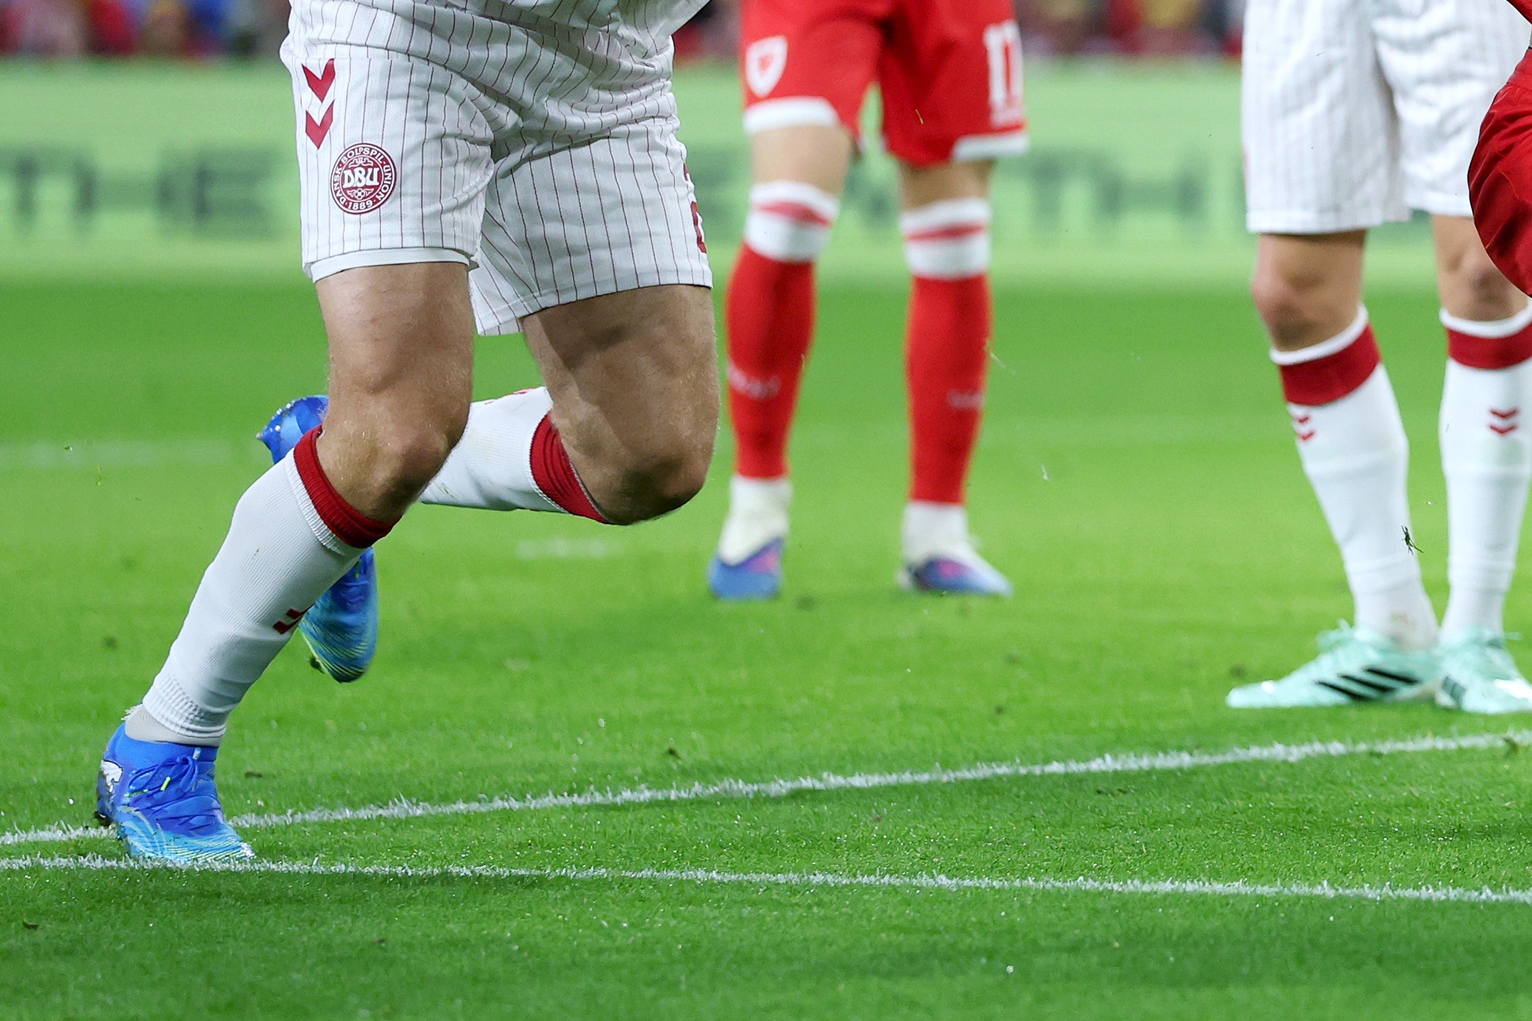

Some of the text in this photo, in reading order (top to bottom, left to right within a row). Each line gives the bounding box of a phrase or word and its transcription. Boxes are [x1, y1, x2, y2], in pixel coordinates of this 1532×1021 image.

[342, 167, 380, 188] DBU
[375, 165, 392, 200] UNION
[348, 200, 373, 210] 1889
